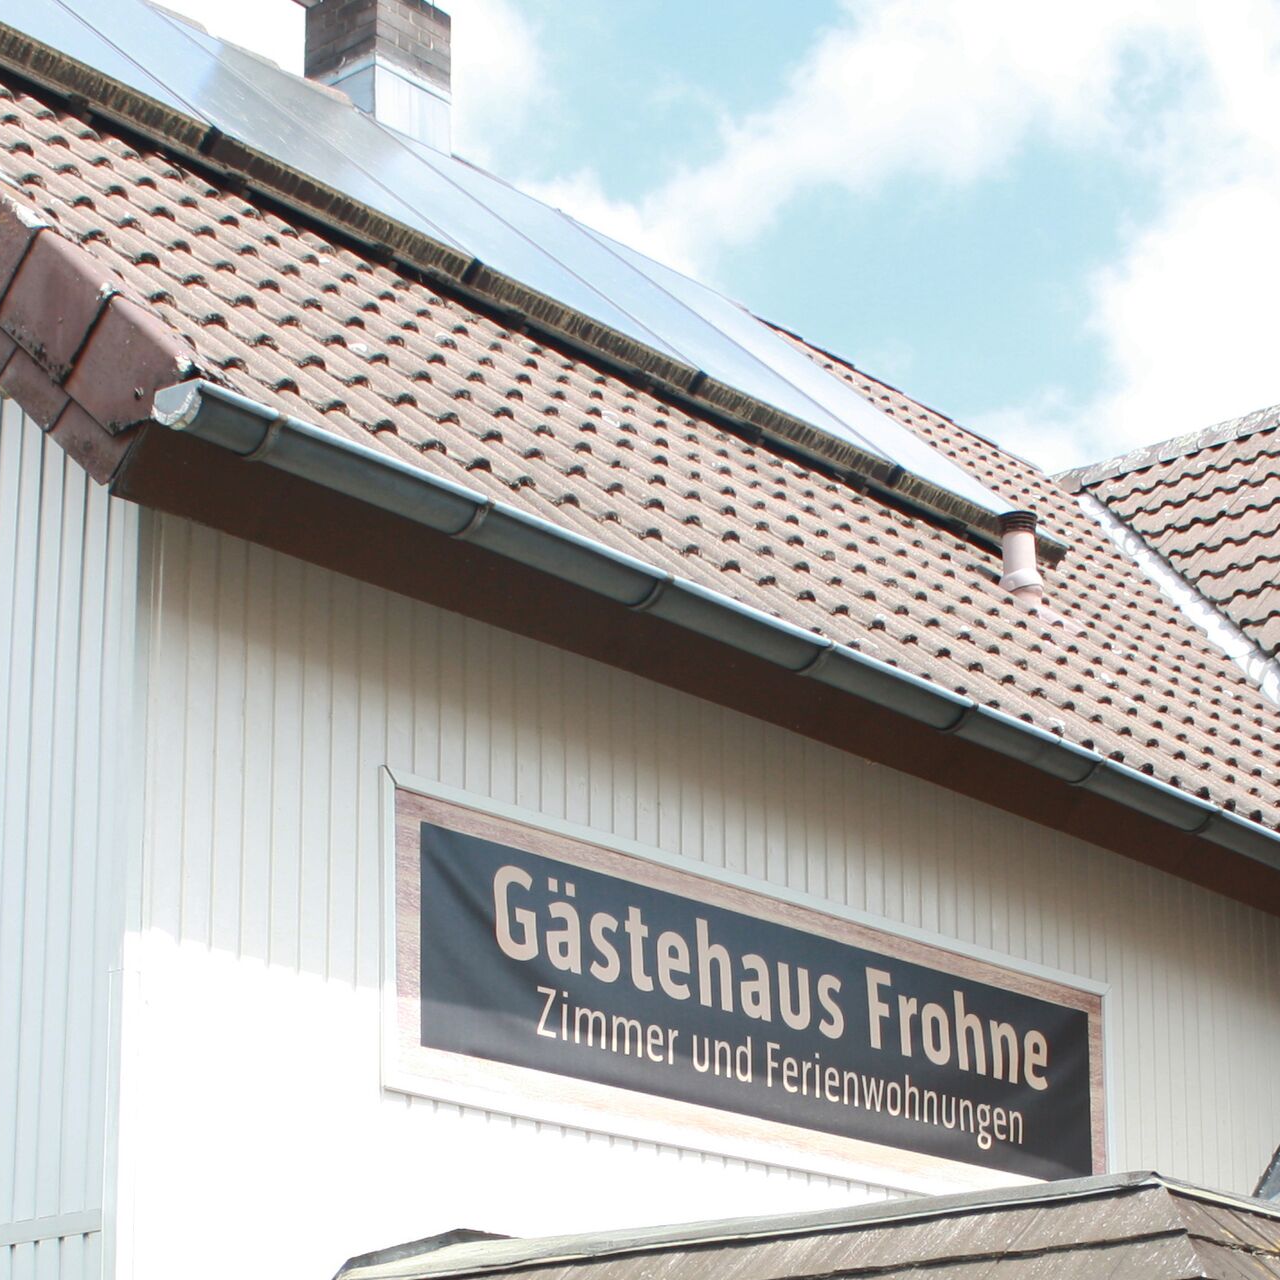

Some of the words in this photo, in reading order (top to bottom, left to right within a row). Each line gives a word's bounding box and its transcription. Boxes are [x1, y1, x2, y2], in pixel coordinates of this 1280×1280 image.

[492, 865, 845, 1039] Gästehaus
[866, 966, 1049, 1091] Frohne
[536, 987, 679, 1066] Zimmer
[691, 1036, 754, 1083] und
[766, 1042, 1024, 1151] Ferienwohnungen
